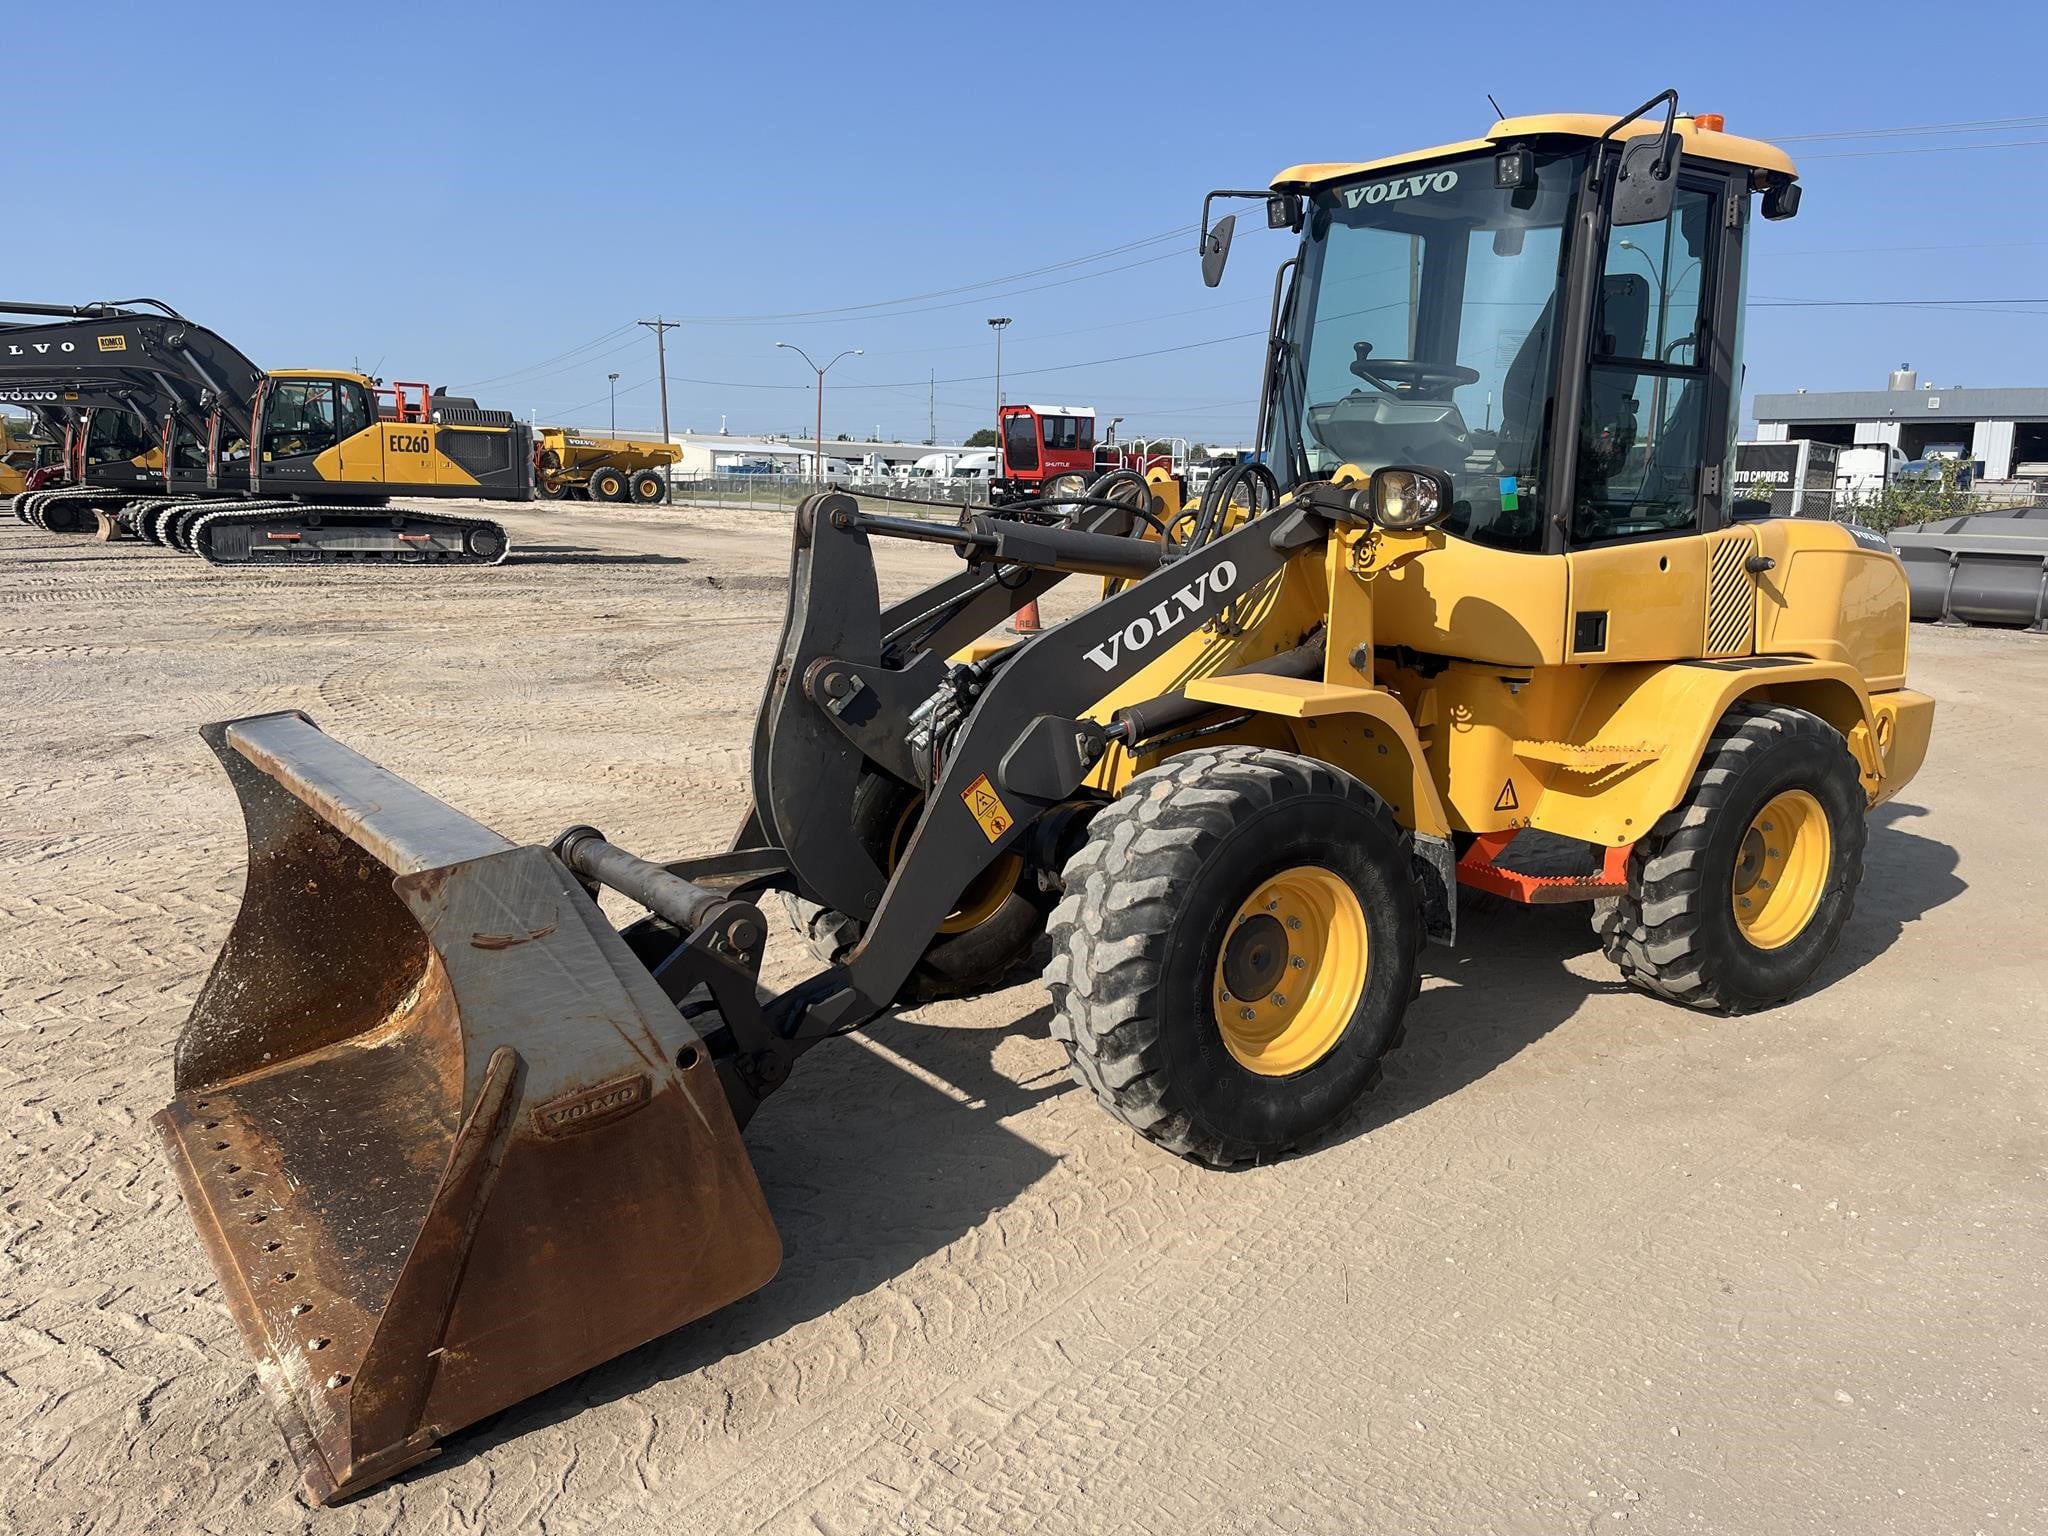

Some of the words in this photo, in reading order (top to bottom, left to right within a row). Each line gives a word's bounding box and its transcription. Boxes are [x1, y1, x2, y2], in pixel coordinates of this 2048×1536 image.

[1344, 170, 1458, 209] VOLVO
[8, 342, 75, 355] LVO
[0, 391, 58, 401] VOLVO
[389, 435, 429, 453] EC260
[1734, 470, 1750, 483] UTO
[1082, 560, 1238, 672] VOLVO
[547, 1087, 635, 1124] VOLVO
